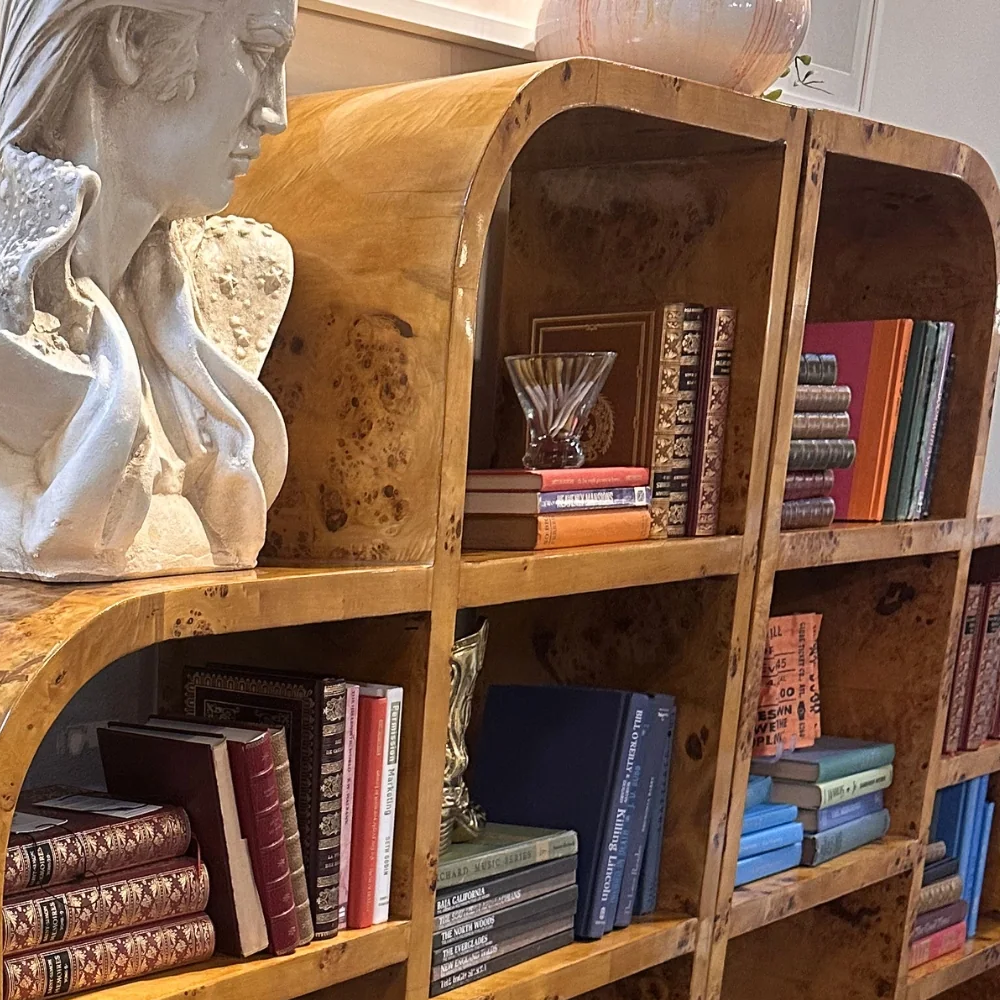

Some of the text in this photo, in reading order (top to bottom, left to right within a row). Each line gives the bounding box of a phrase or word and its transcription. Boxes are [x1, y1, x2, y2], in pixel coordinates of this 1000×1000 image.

[388, 704, 400, 762] Permission
[633, 710, 644, 730] BILL
[384, 768, 395, 816] Marketing
[608, 808, 626, 852] Killing
[436, 866, 468, 882] CHARD
[474, 858, 500, 872] MUSIC
[504, 852, 532, 865] SERIES
[601, 856, 618, 902] Lincoln
[436, 887, 486, 910] BAJA CALIFORNIA
[441, 915, 495, 940] THE NORTH WOODS
[442, 934, 488, 958] THE EVERGLADES
[440, 960, 454, 972] NEW
